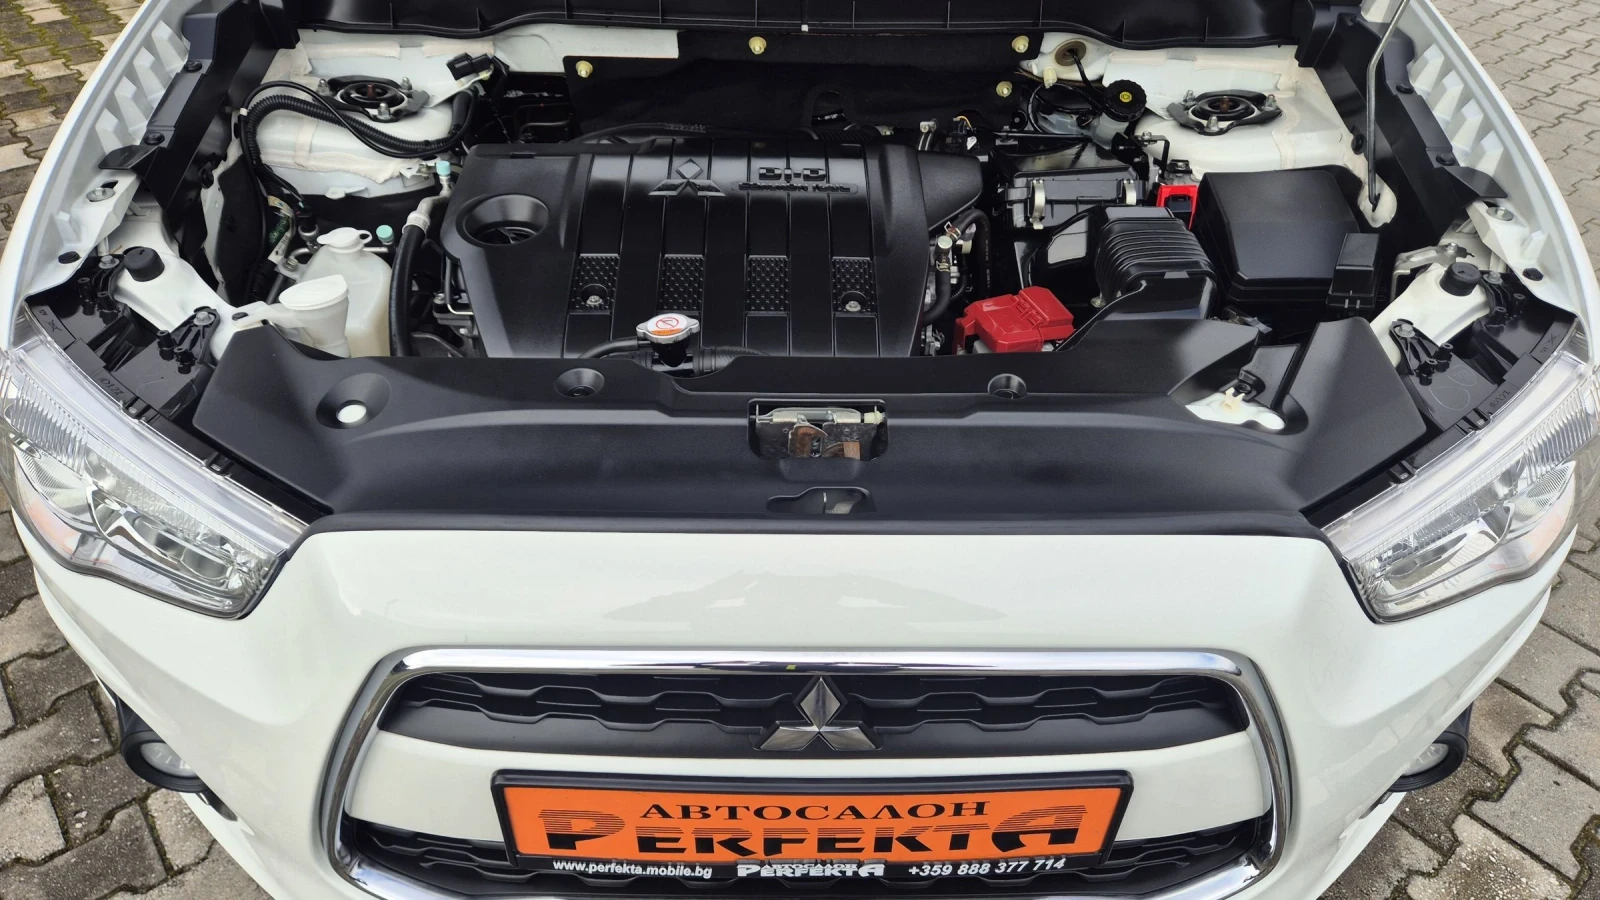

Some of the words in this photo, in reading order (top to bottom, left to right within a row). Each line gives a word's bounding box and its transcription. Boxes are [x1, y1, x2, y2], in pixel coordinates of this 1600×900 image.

[640, 801, 991, 820] АВТОСАЛОН
[538, 805, 1087, 857] PERFEKTA
[553, 859, 712, 879] www.perfekta.mobile.bg
[737, 863, 886, 877] PERFEKTA
[908, 864, 953, 876] +359
[957, 863, 991, 875] 888
[994, 861, 1030, 873] 377
[1032, 857, 1067, 871] 714
